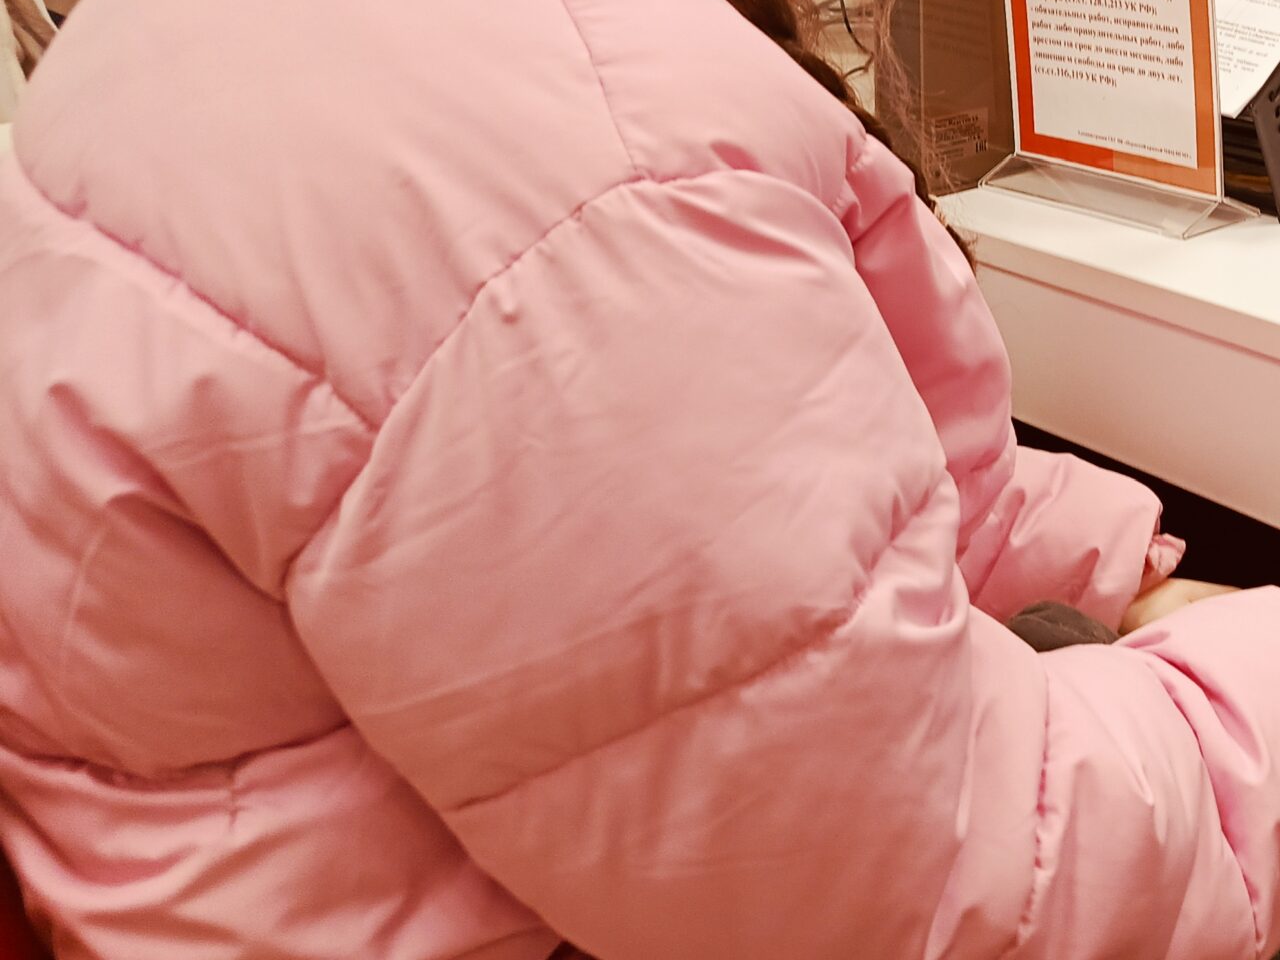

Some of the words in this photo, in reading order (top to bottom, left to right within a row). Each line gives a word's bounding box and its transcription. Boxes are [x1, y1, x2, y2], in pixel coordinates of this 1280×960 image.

[1034, 4, 1087, 20] обязательных
[1113, 17, 1179, 34] исправительных
[1124, 0, 1137, 12] УК
[1031, 19, 1052, 30] работ
[1054, 22, 1072, 33] либо
[1073, 27, 1138, 43] принудительных
[1166, 40, 1185, 51] либо
[1032, 36, 1062, 47] арестом
[1063, 40, 1073, 48] на
[1074, 42, 1092, 54] срок
[1104, 47, 1128, 58] шести
[1165, 56, 1184, 67] либо
[1034, 51, 1073, 63] лишением
[1073, 56, 1105, 70] свободы
[1106, 62, 1116, 70] на
[1117, 64, 1135, 76] срок
[1147, 69, 1166, 81] двух
[1085, 72, 1098, 82] УК
